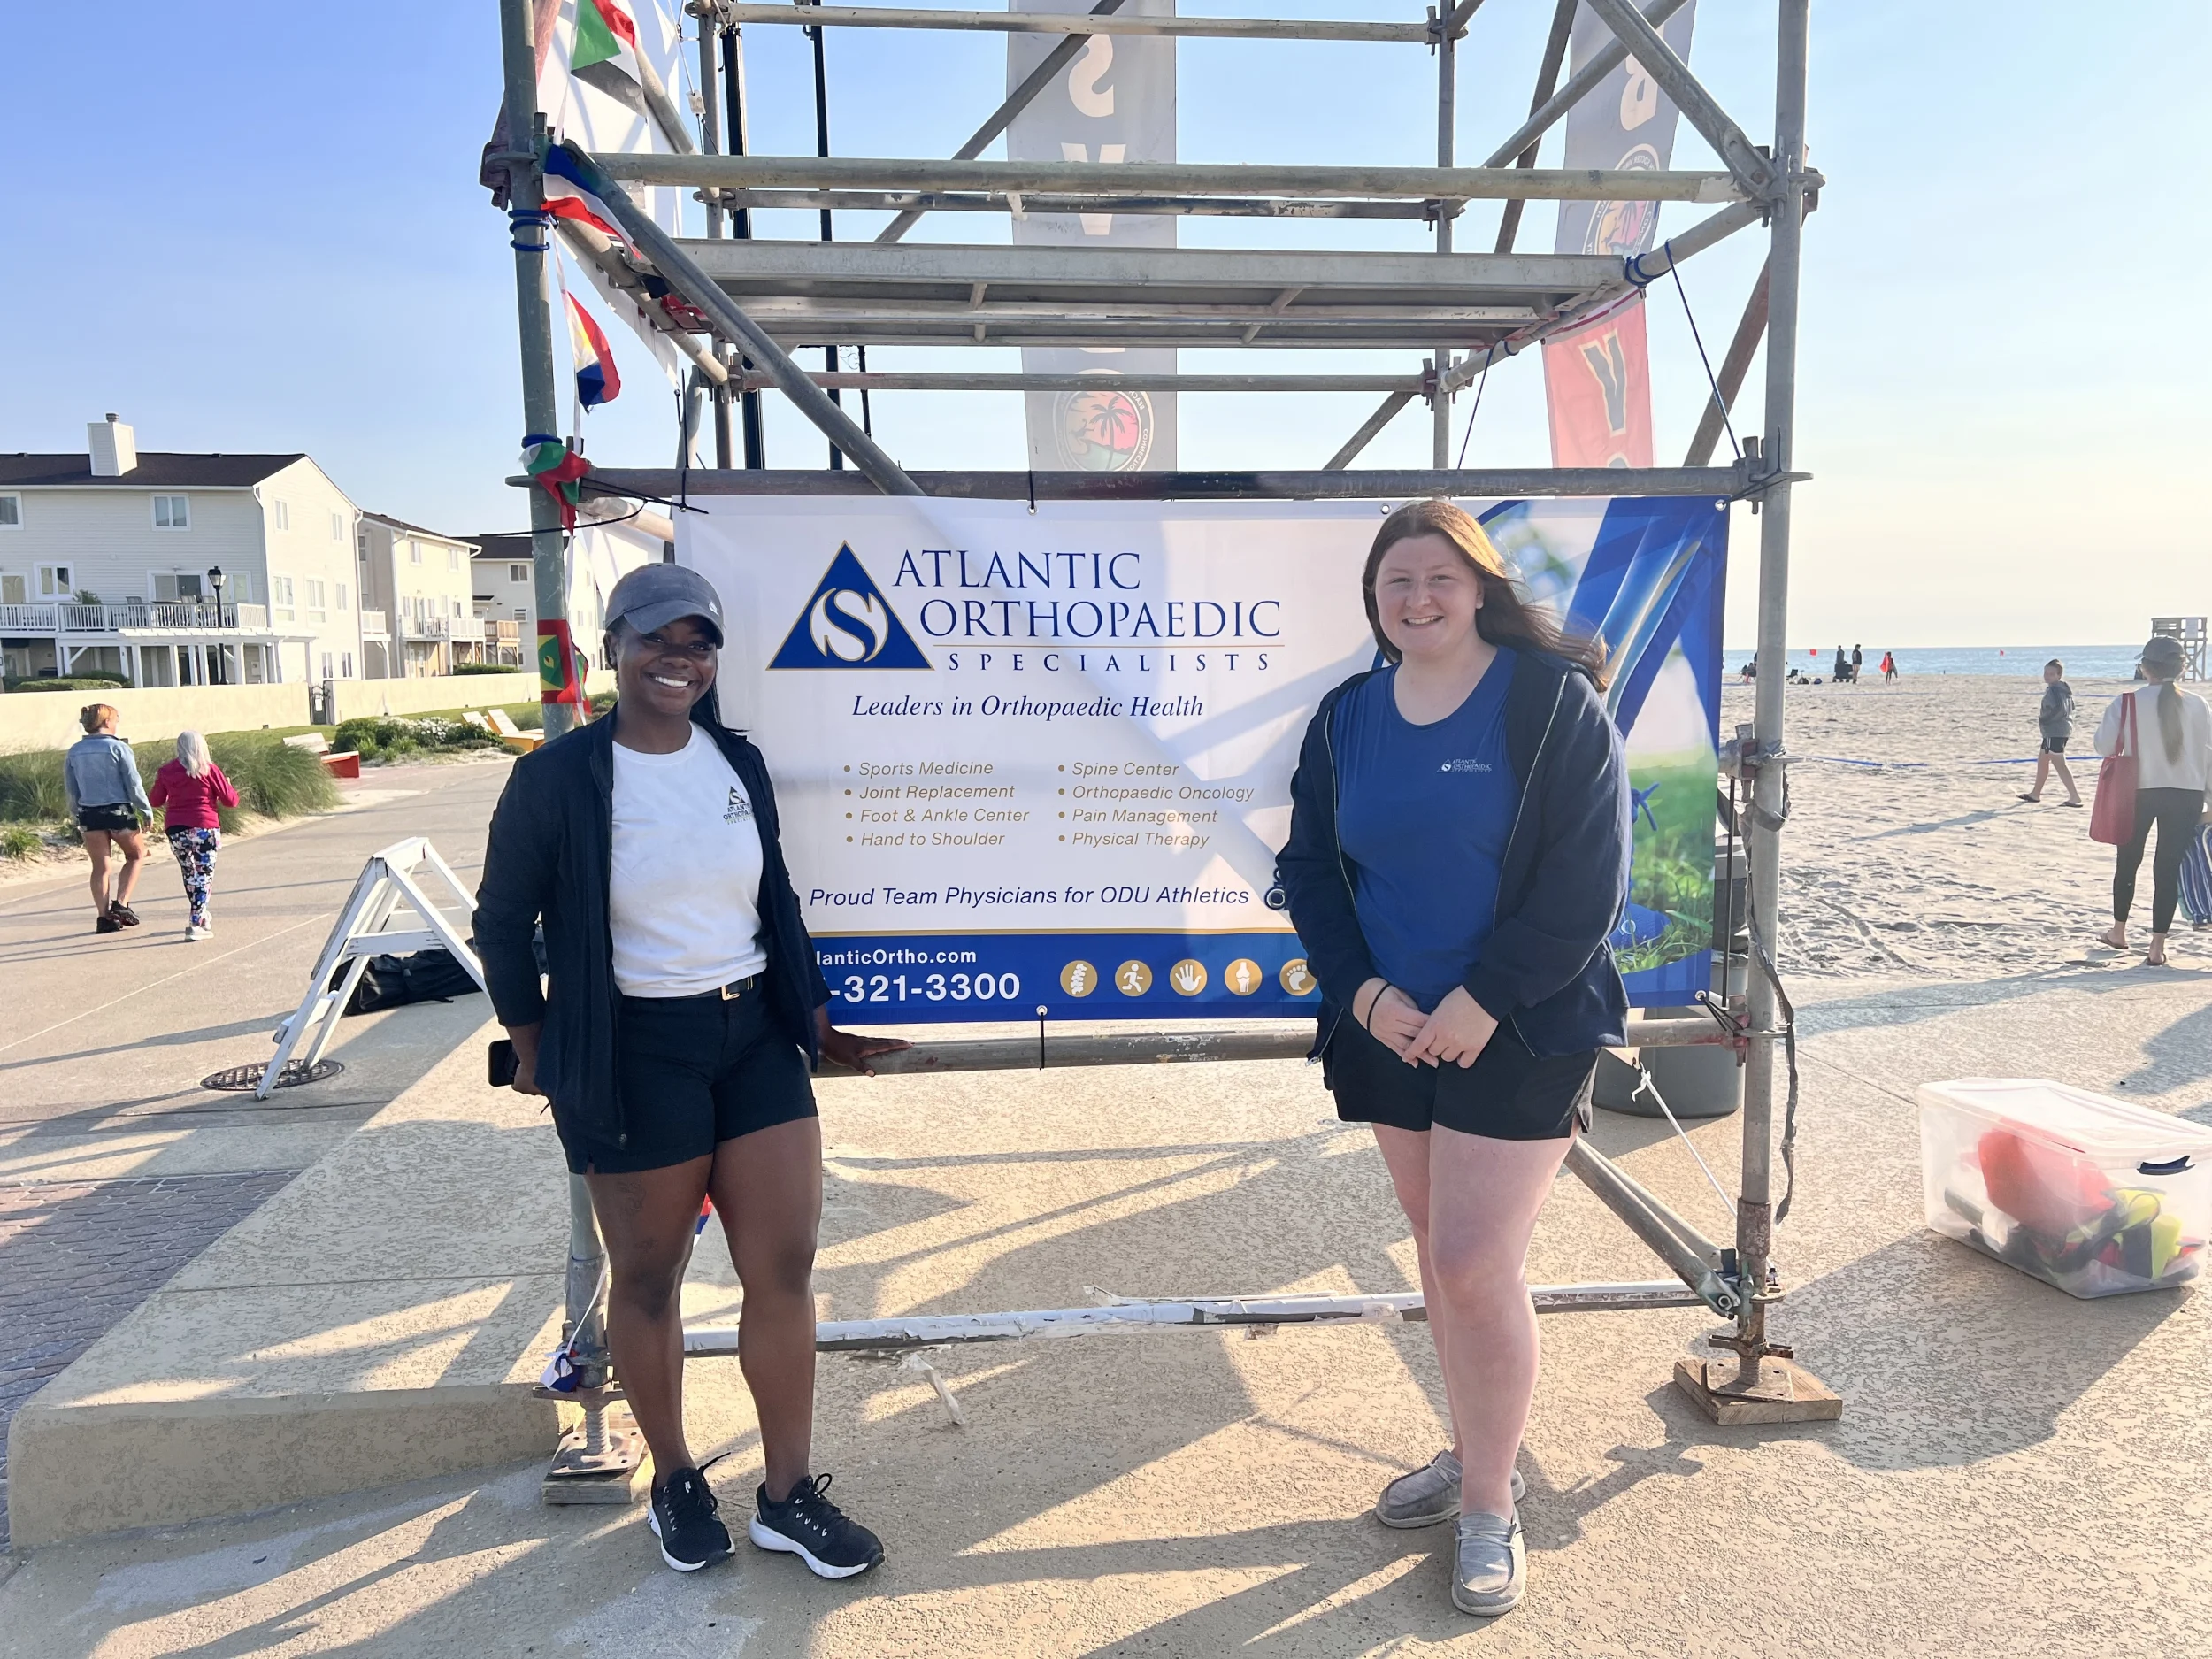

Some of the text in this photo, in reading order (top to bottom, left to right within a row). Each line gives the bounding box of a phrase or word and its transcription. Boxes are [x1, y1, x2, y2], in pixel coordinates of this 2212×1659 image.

[892, 549, 1140, 589] ATLANTIC
[920, 599, 1279, 637] ORTHOPAEDIC
[949, 653, 1267, 671] SPECIALISTS
[852, 695, 1202, 721] Leaders in Orthopaedic Health
[859, 762, 993, 779] Sports Medicine
[1072, 762, 1179, 779] Spine Center
[860, 786, 1015, 802] Joint Replacement
[1073, 786, 1254, 802] Orthopaedic Oncology
[861, 809, 1029, 822] Foot & Ankle Center
[1072, 809, 1217, 826] Pain Management
[862, 832, 1005, 846] Hand to Shoulder
[1073, 833, 1210, 849] Physical Therapy
[810, 887, 1248, 908] Proud Team Physicians for ODU Athletics
[824, 973, 1020, 1003] -321-3300
